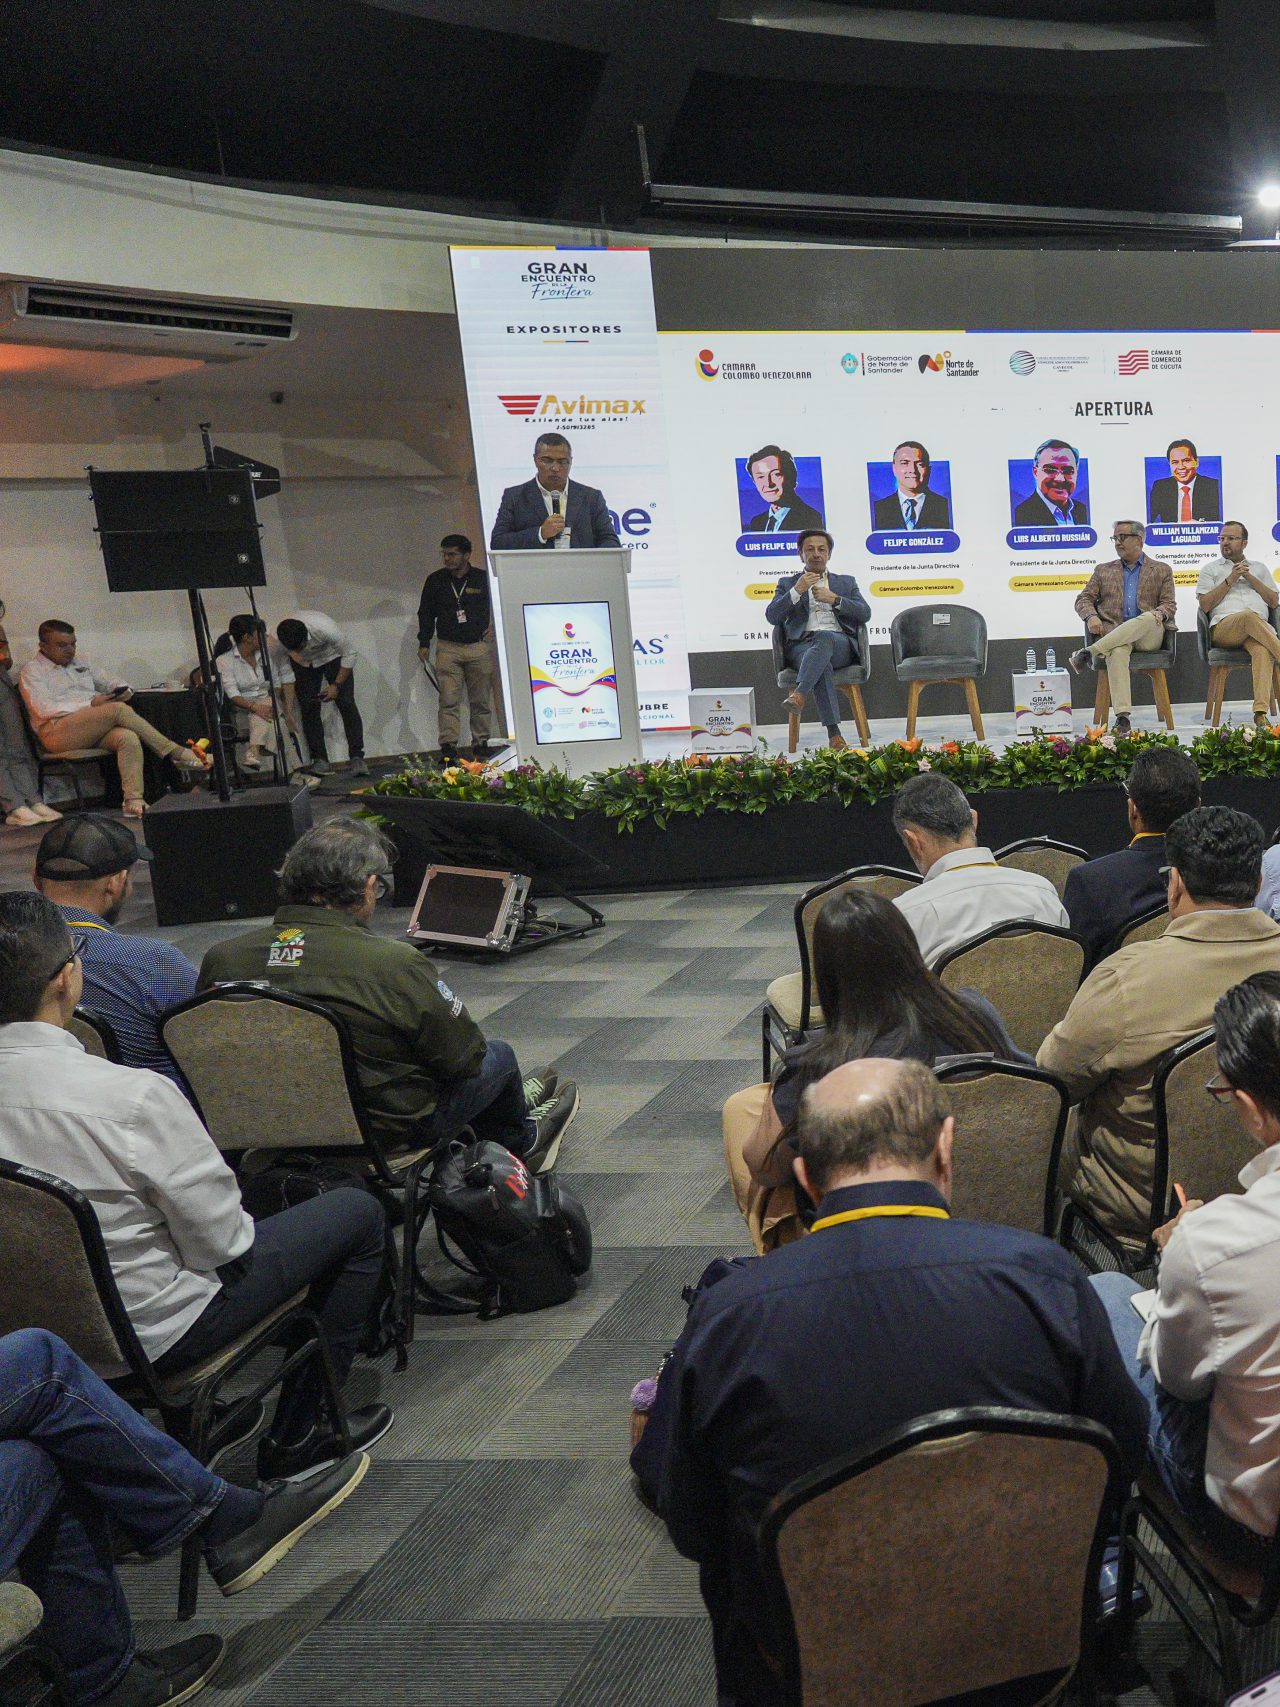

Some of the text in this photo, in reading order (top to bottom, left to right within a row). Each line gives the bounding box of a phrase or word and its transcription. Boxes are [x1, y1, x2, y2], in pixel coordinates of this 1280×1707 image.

[527, 262, 588, 275] GRAN
[521, 274, 596, 283] ENCUENTRO
[531, 283, 593, 300] Frontera
[506, 325, 622, 334] EXPOSITORES
[945, 360, 974, 368] Norte de
[722, 371, 812, 380] COLOMBO VENEZOLANA
[946, 368, 980, 377] Santander
[540, 394, 647, 415] Avimax
[1075, 401, 1154, 416] APERTURA
[1152, 526, 1219, 536] WILLIAM VILLAMIZAR
[883, 536, 944, 547] FELIPE GONZÁLEZ
[1013, 532, 1091, 543] LUIS ALBERTO RUSSIÁN
[1171, 535, 1201, 543] LAGUADO
[745, 542, 798, 551] LUIS FELIPE QUI
[744, 632, 769, 640] GRAN
[549, 648, 592, 659] GRAN
[545, 657, 598, 666] ENCUENTRO
[269, 947, 304, 961] RAP
